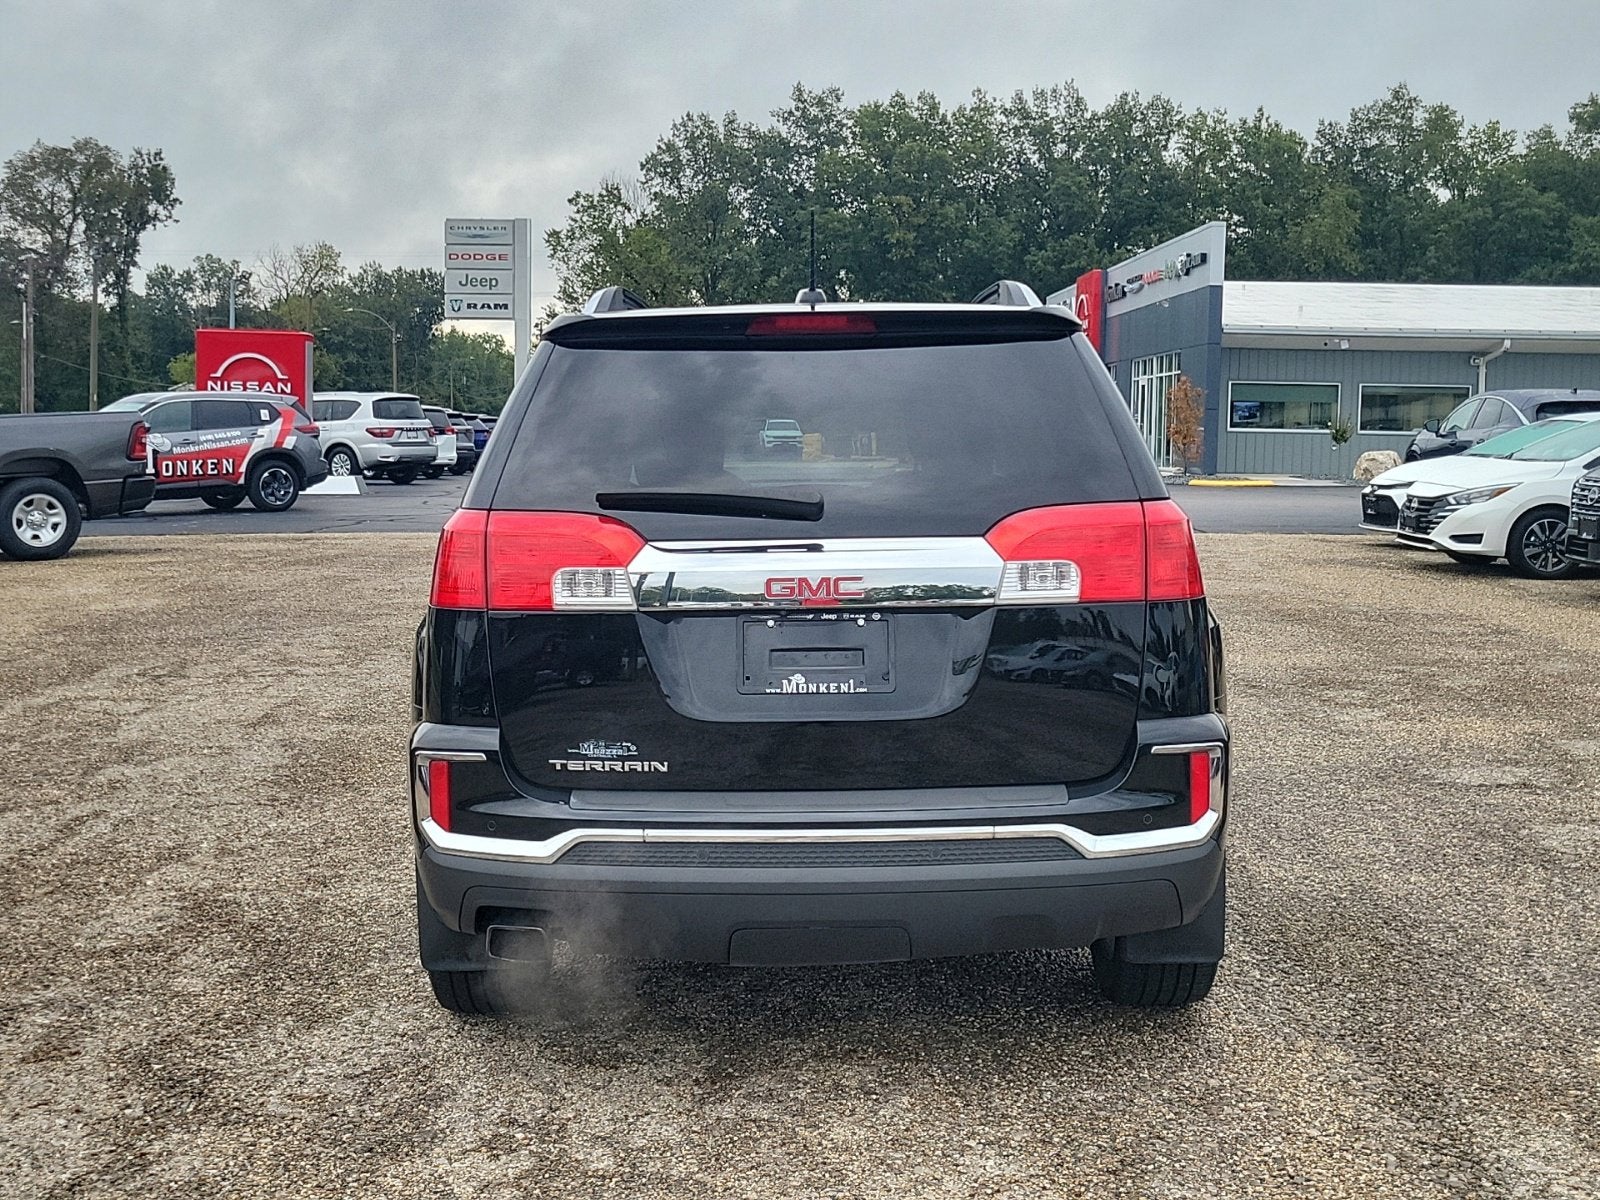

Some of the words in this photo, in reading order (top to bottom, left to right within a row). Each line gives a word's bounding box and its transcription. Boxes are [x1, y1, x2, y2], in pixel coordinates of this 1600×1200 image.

[448, 253, 509, 261] DODGE
[459, 273, 499, 291] Jeep
[207, 380, 292, 394] NISSAN
[172, 436, 249, 455] MonkenNissan.com
[764, 575, 865, 599] GMC
[548, 759, 669, 772] TERRAIN
